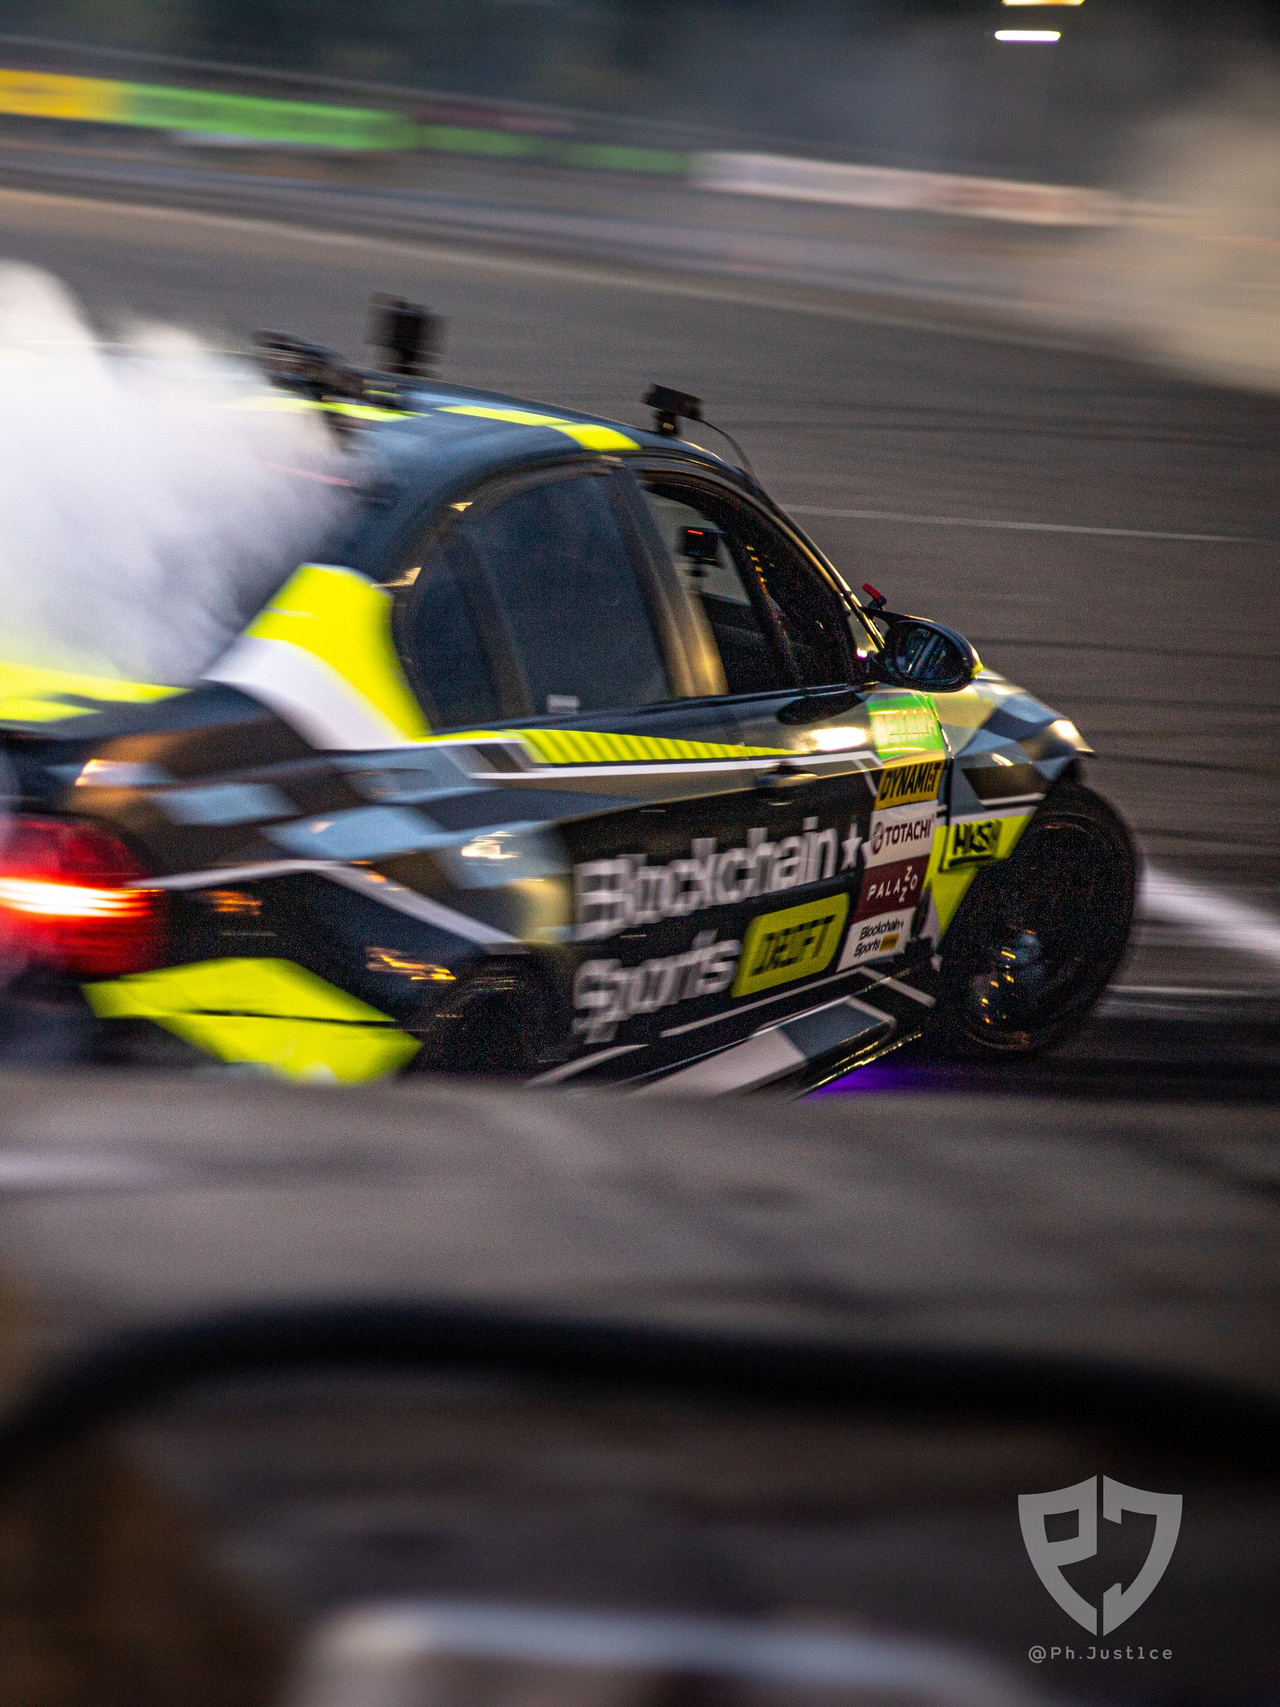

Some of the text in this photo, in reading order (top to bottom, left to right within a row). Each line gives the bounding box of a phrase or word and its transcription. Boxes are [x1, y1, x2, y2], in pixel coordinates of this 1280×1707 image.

[885, 817, 932, 847] TOTACHI
[572, 816, 839, 943] Blockchain
[866, 865, 918, 903] PALAZZO
